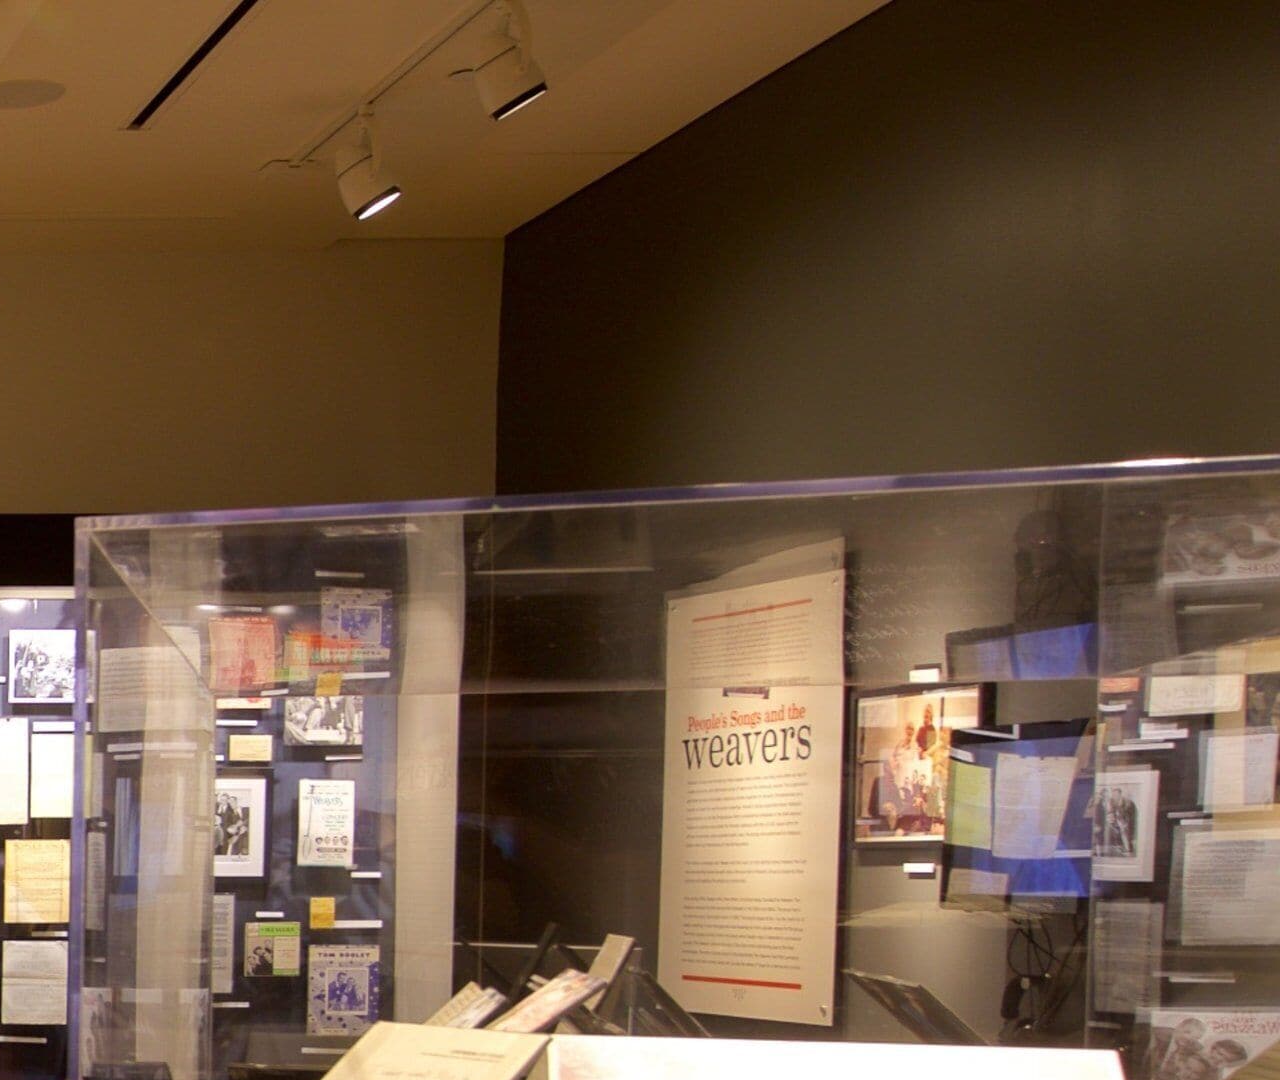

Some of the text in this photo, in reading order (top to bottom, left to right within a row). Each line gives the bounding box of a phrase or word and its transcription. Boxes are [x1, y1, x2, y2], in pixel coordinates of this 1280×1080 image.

[687, 702, 807, 734] People's Songs and the
[681, 723, 813, 771] weavers
